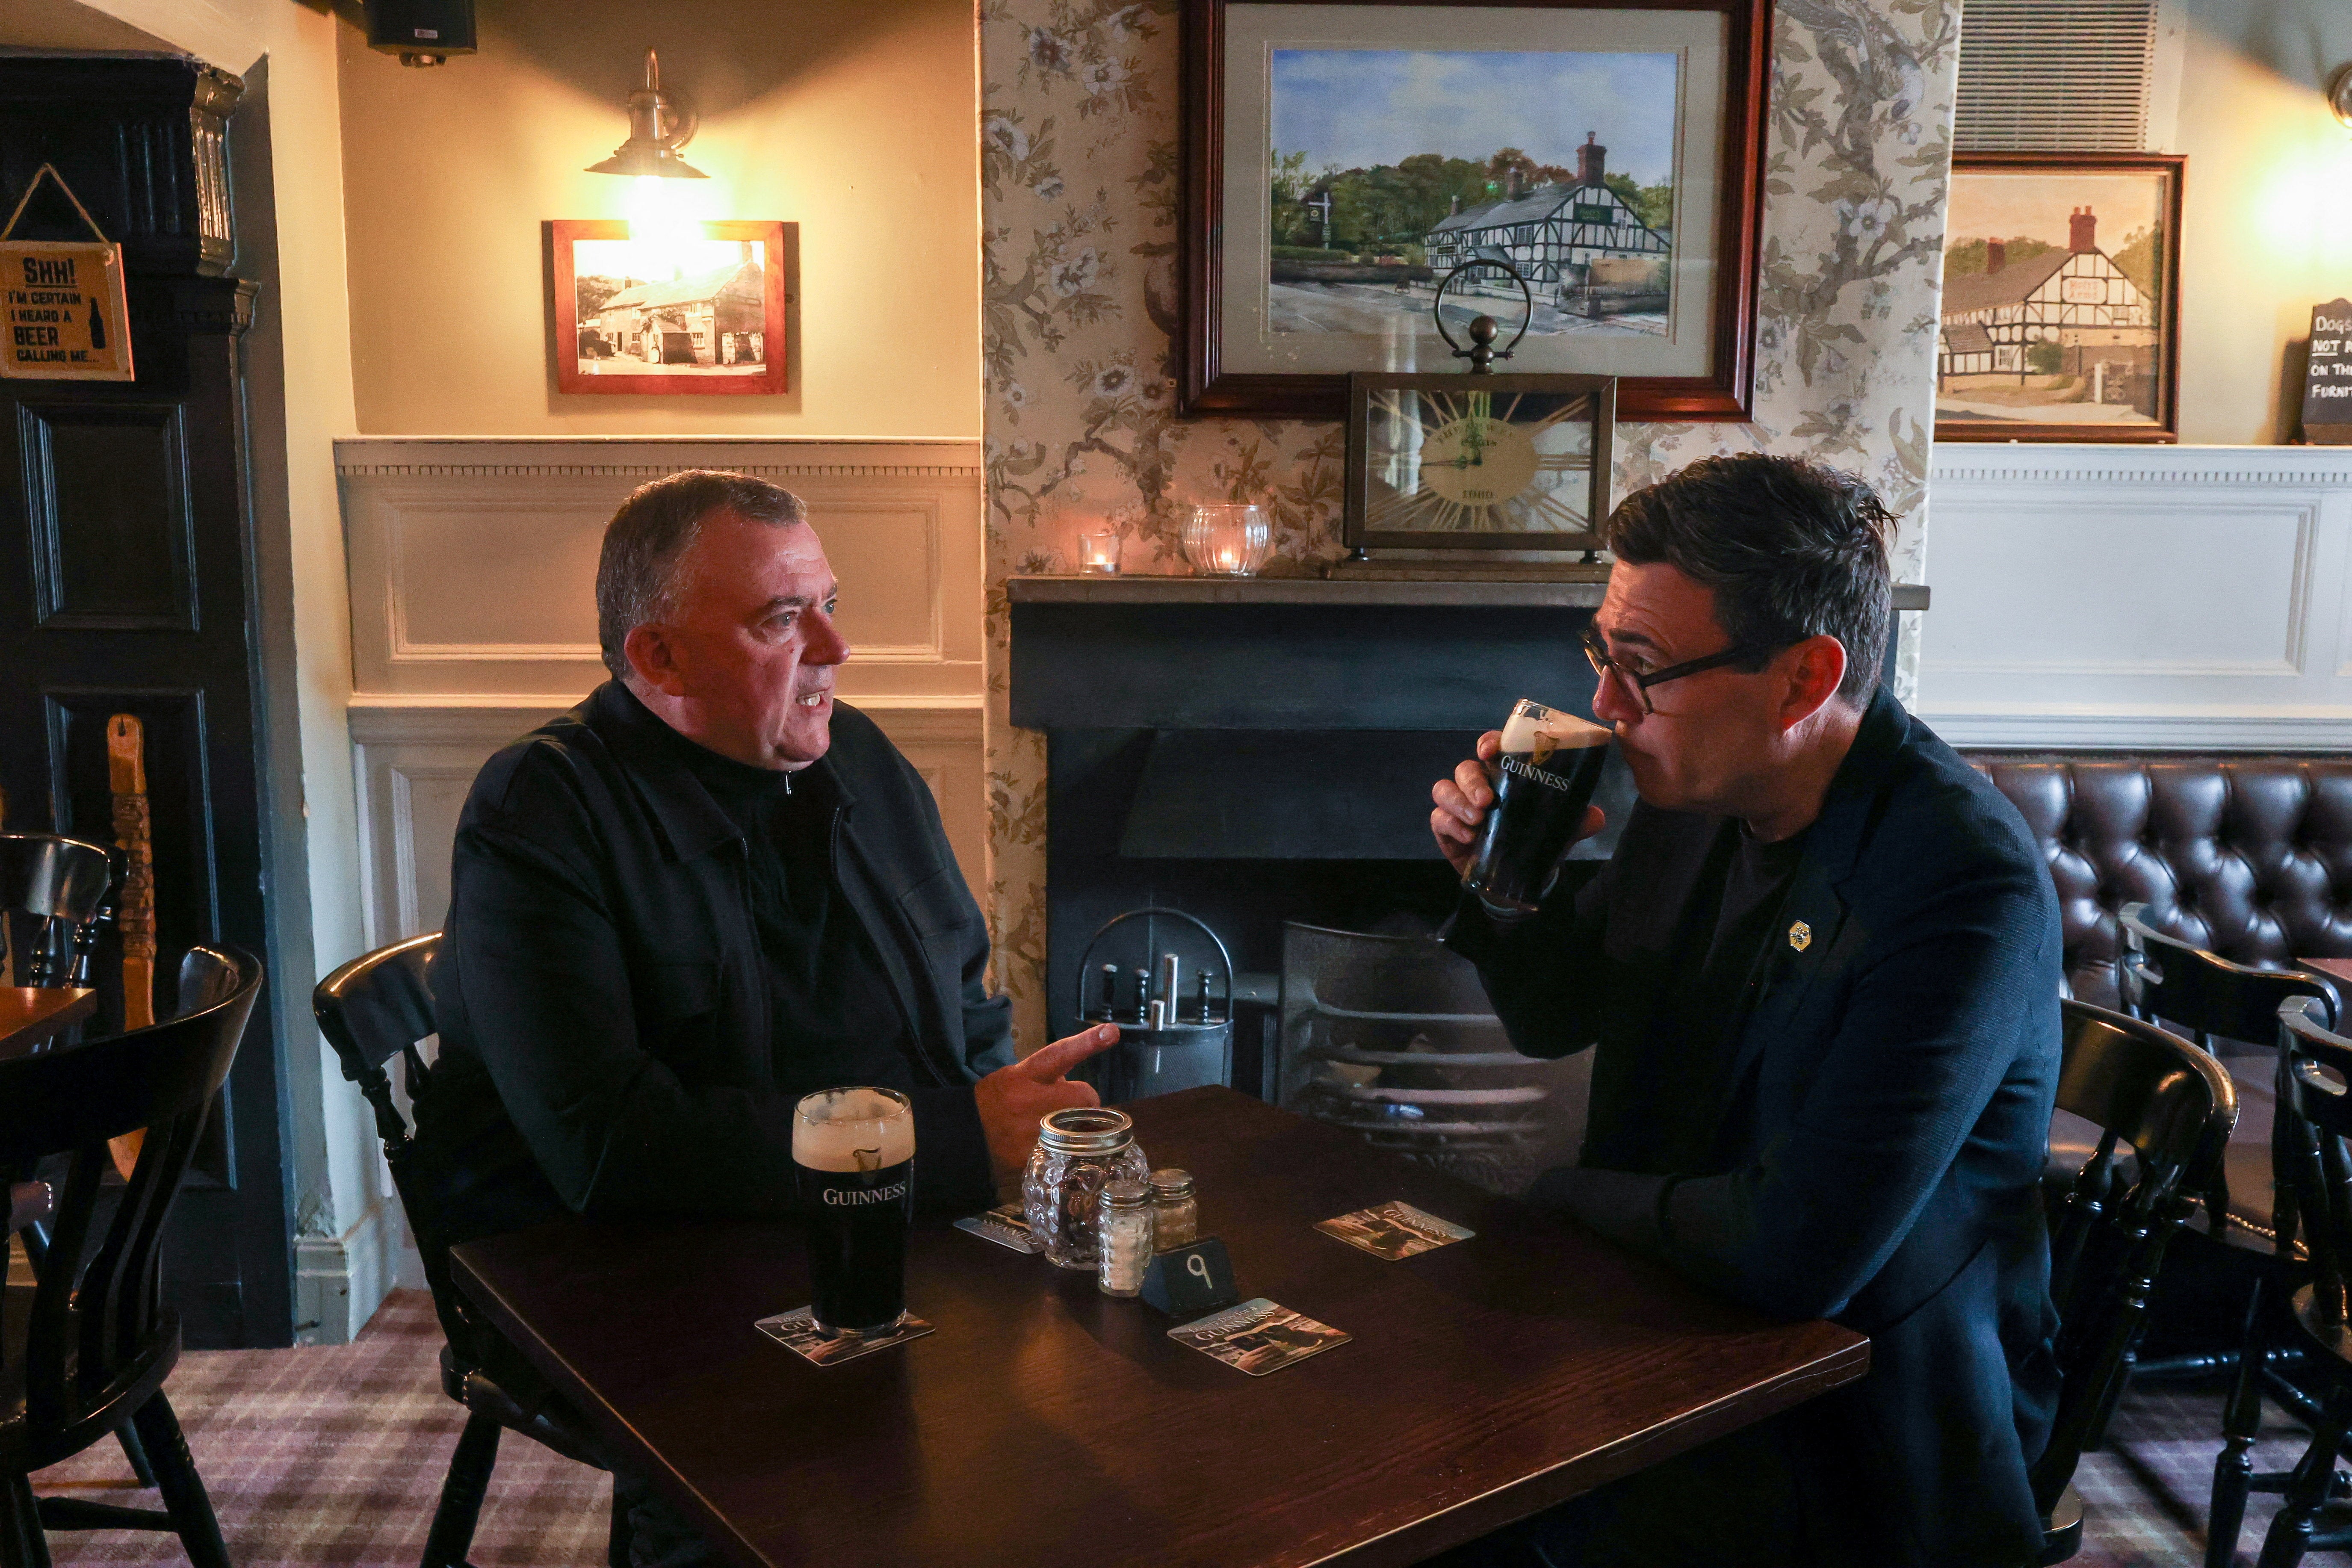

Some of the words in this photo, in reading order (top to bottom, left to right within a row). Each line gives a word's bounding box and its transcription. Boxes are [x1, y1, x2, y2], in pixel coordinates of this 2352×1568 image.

[23, 257, 76, 284] SHH!
[8, 290, 27, 304] I'M
[31, 292, 82, 305] CERTAIN
[11, 309, 15, 322] I
[19, 310, 59, 322] HEARD
[63, 311, 73, 323] A
[14, 325, 59, 345] BEER
[2312, 339, 2341, 352] NOT
[17, 349, 67, 362] CALLING
[2310, 364, 2329, 376] ON
[1501, 755, 1570, 791] GUINNESS
[823, 1181, 906, 1205] GUINNESS
[1187, 1254, 1212, 1289] 9
[1188, 1320, 1219, 1333] Lovely
[1218, 1314, 1236, 1323] Day
[1195, 1309, 1275, 1340] GUINNESS
